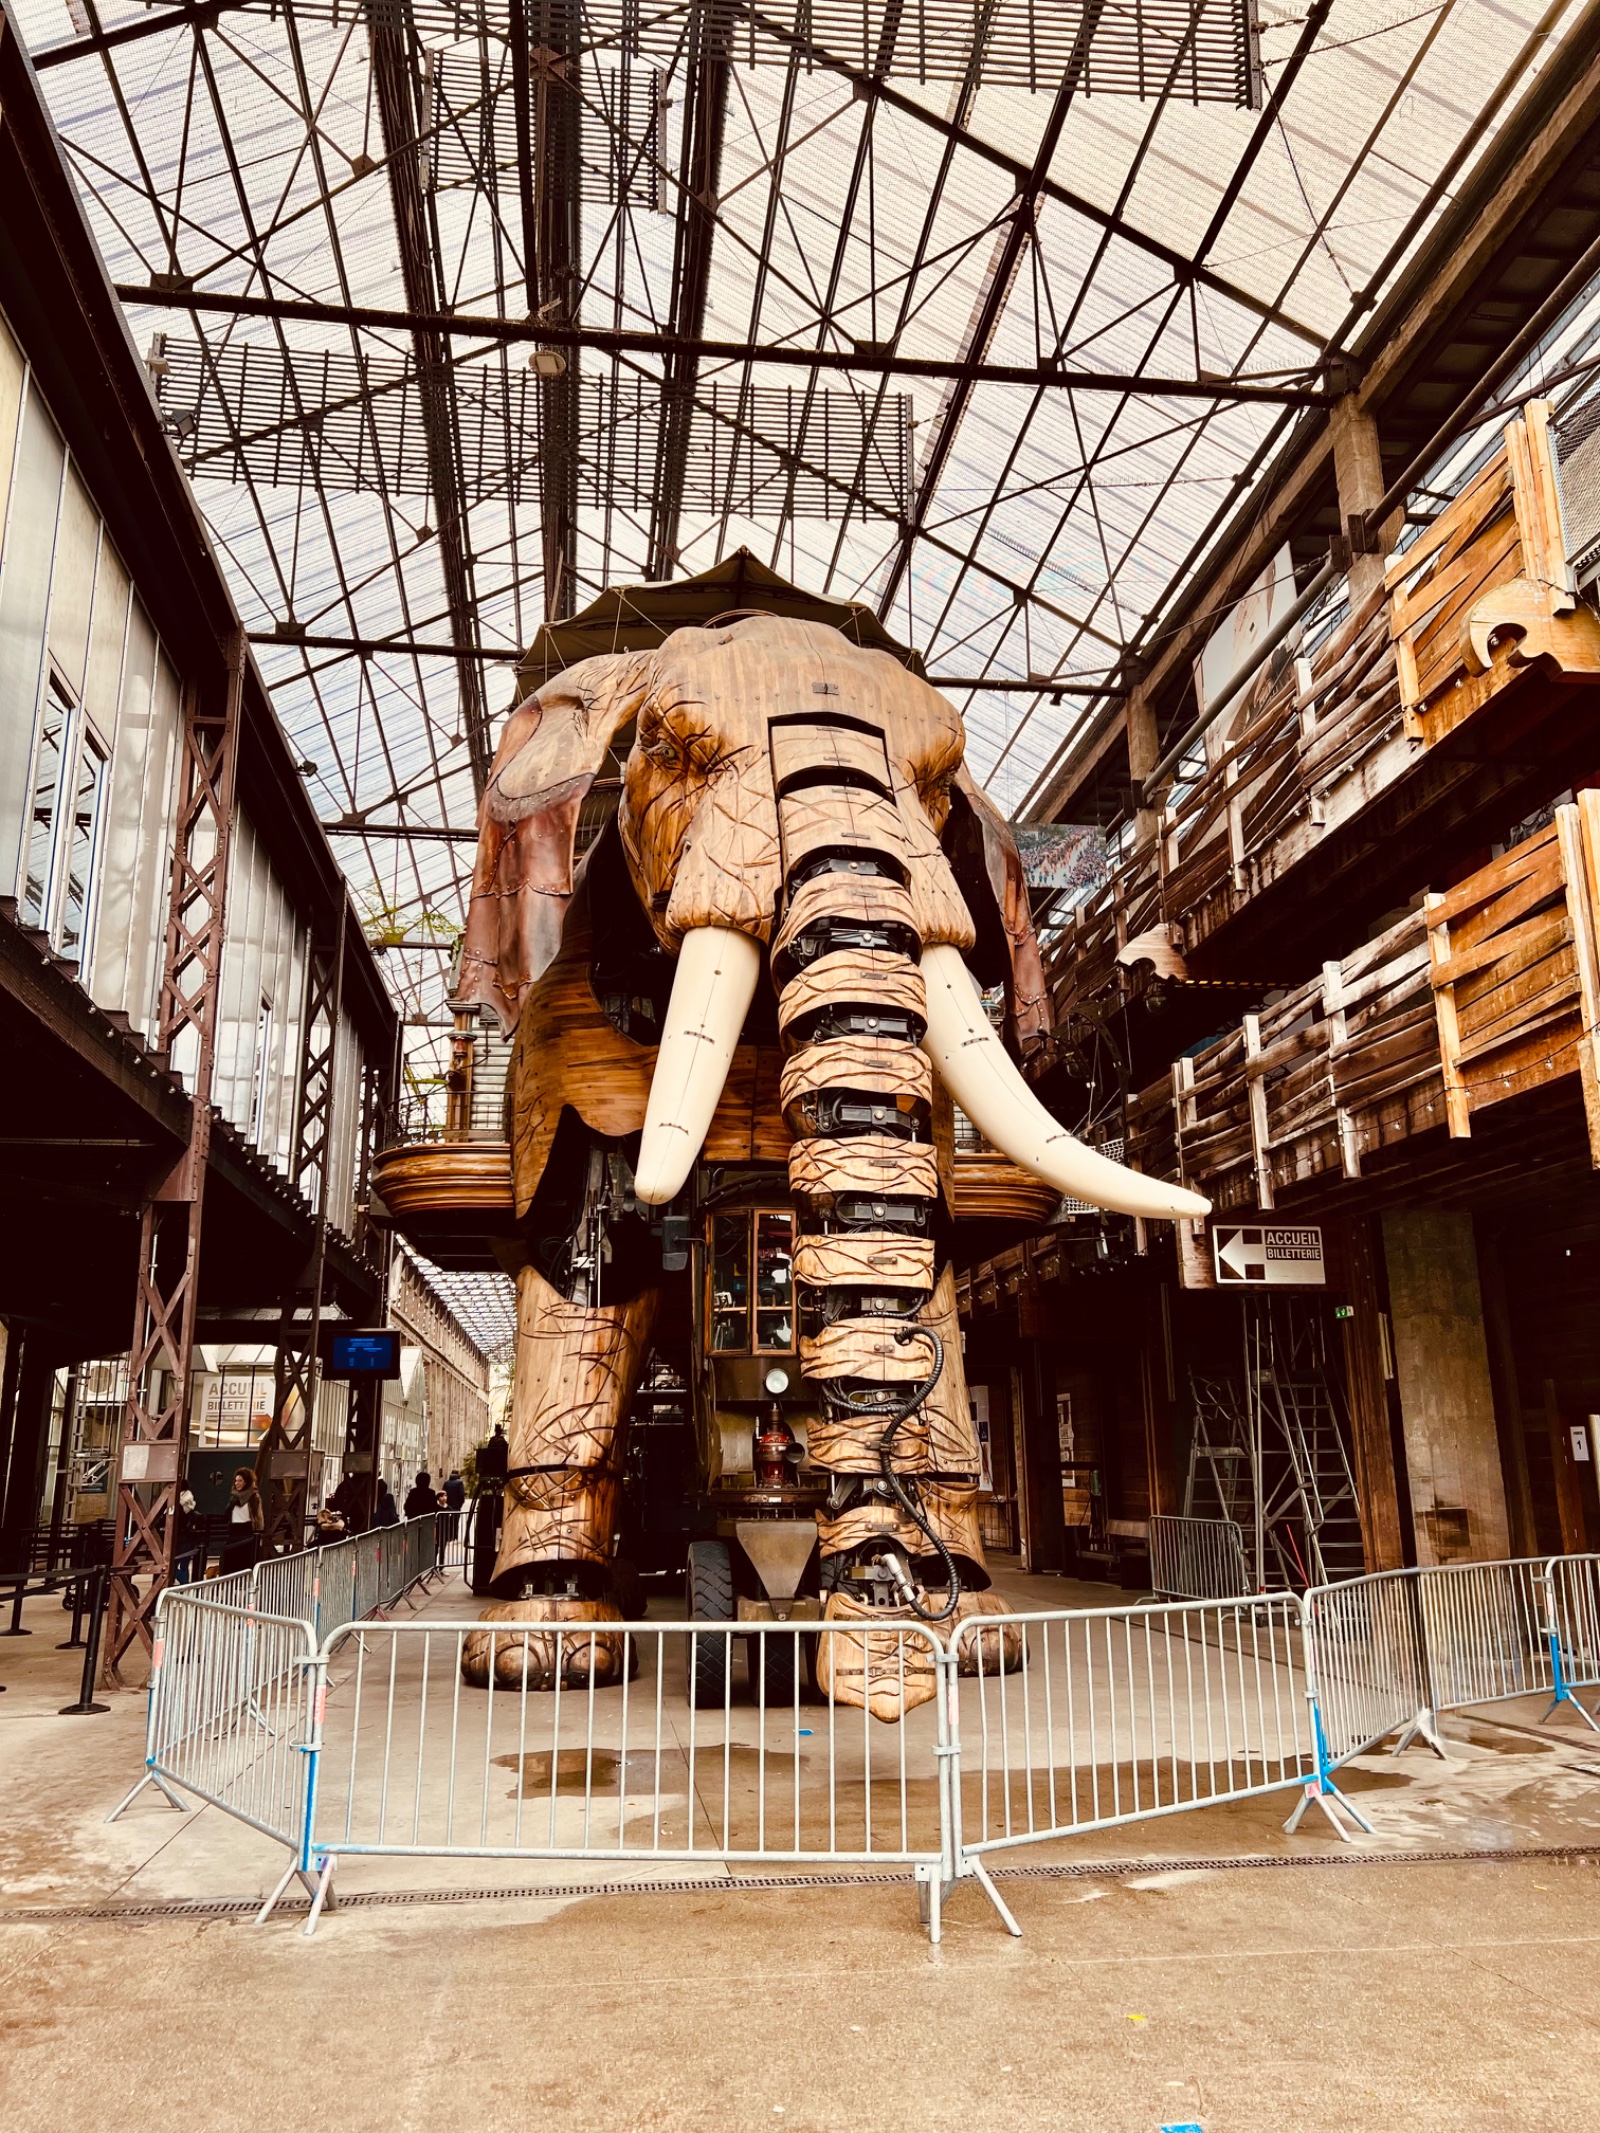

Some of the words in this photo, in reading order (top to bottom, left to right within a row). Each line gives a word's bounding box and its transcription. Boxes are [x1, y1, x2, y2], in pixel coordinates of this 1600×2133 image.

[1266, 1232, 1319, 1245] ACCUEIL
[1267, 1248, 1321, 1259] BILLETTERIE
[1577, 1440, 1582, 1450] 1
